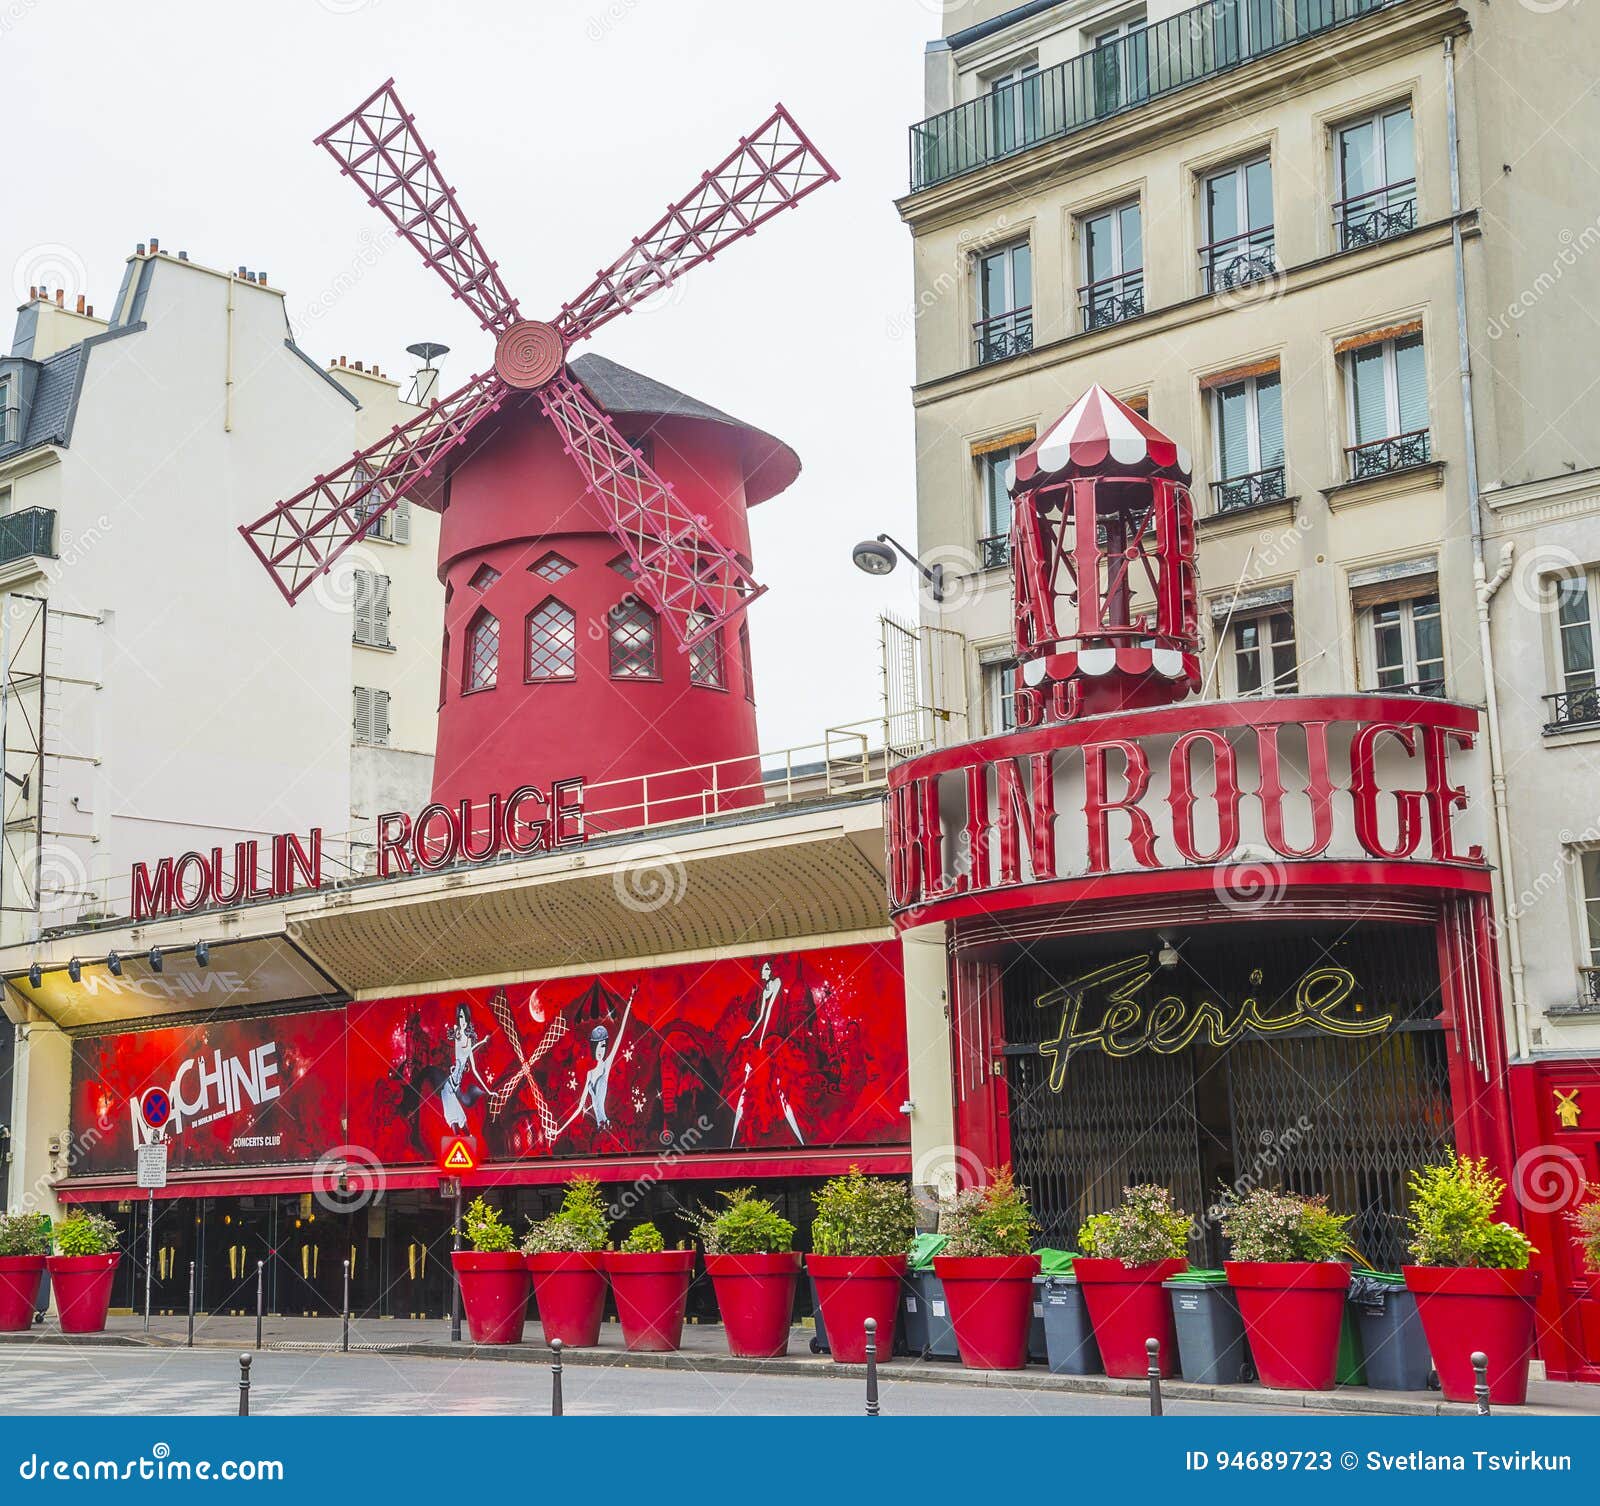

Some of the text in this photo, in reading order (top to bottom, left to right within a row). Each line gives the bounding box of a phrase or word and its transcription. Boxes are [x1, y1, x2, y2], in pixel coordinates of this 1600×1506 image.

[1015, 679, 1083, 728] DU
[130, 827, 322, 920] MOULIN
[376, 775, 590, 877] ROUGE
[1081, 722, 1488, 875] ROUGE
[1035, 954, 1393, 1093] Féerie
[233, 1135, 281, 1148] CONCERTS CLUB
